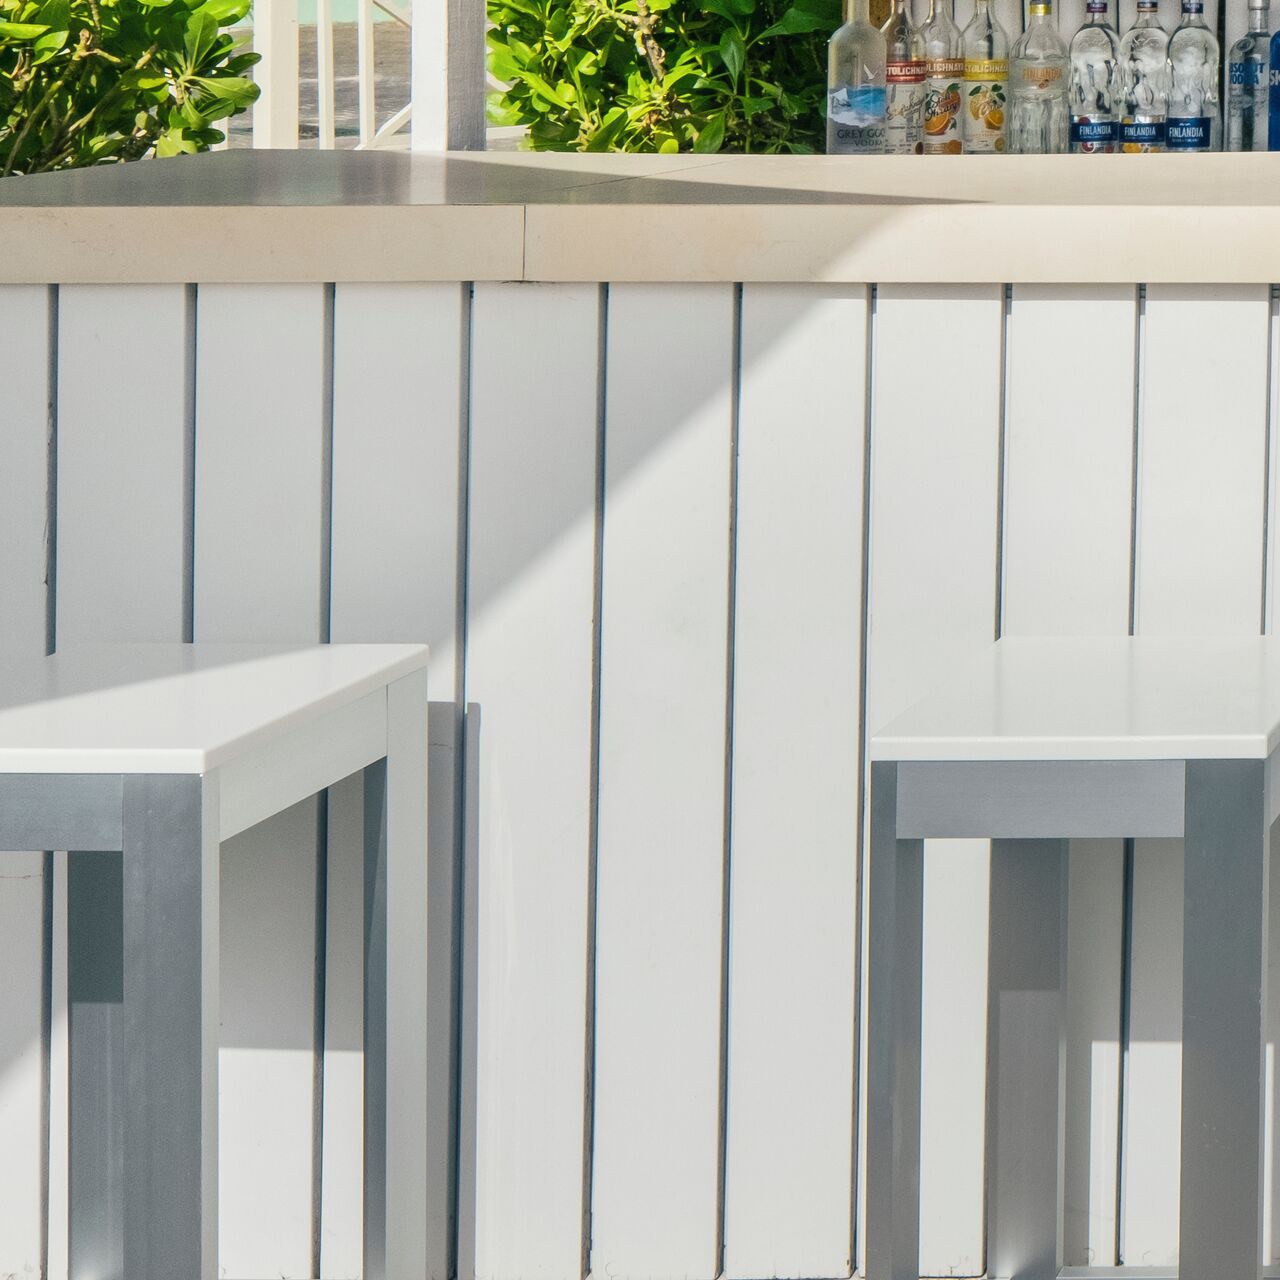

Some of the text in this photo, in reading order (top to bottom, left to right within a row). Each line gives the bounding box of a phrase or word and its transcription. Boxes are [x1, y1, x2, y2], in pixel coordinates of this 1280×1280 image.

[837, 127, 885, 139] GREY GOO
[1079, 125, 1112, 136] FINLANDIA
[1124, 126, 1156, 137] FINLANDIA
[1169, 126, 1204, 138] FINLANDIA
